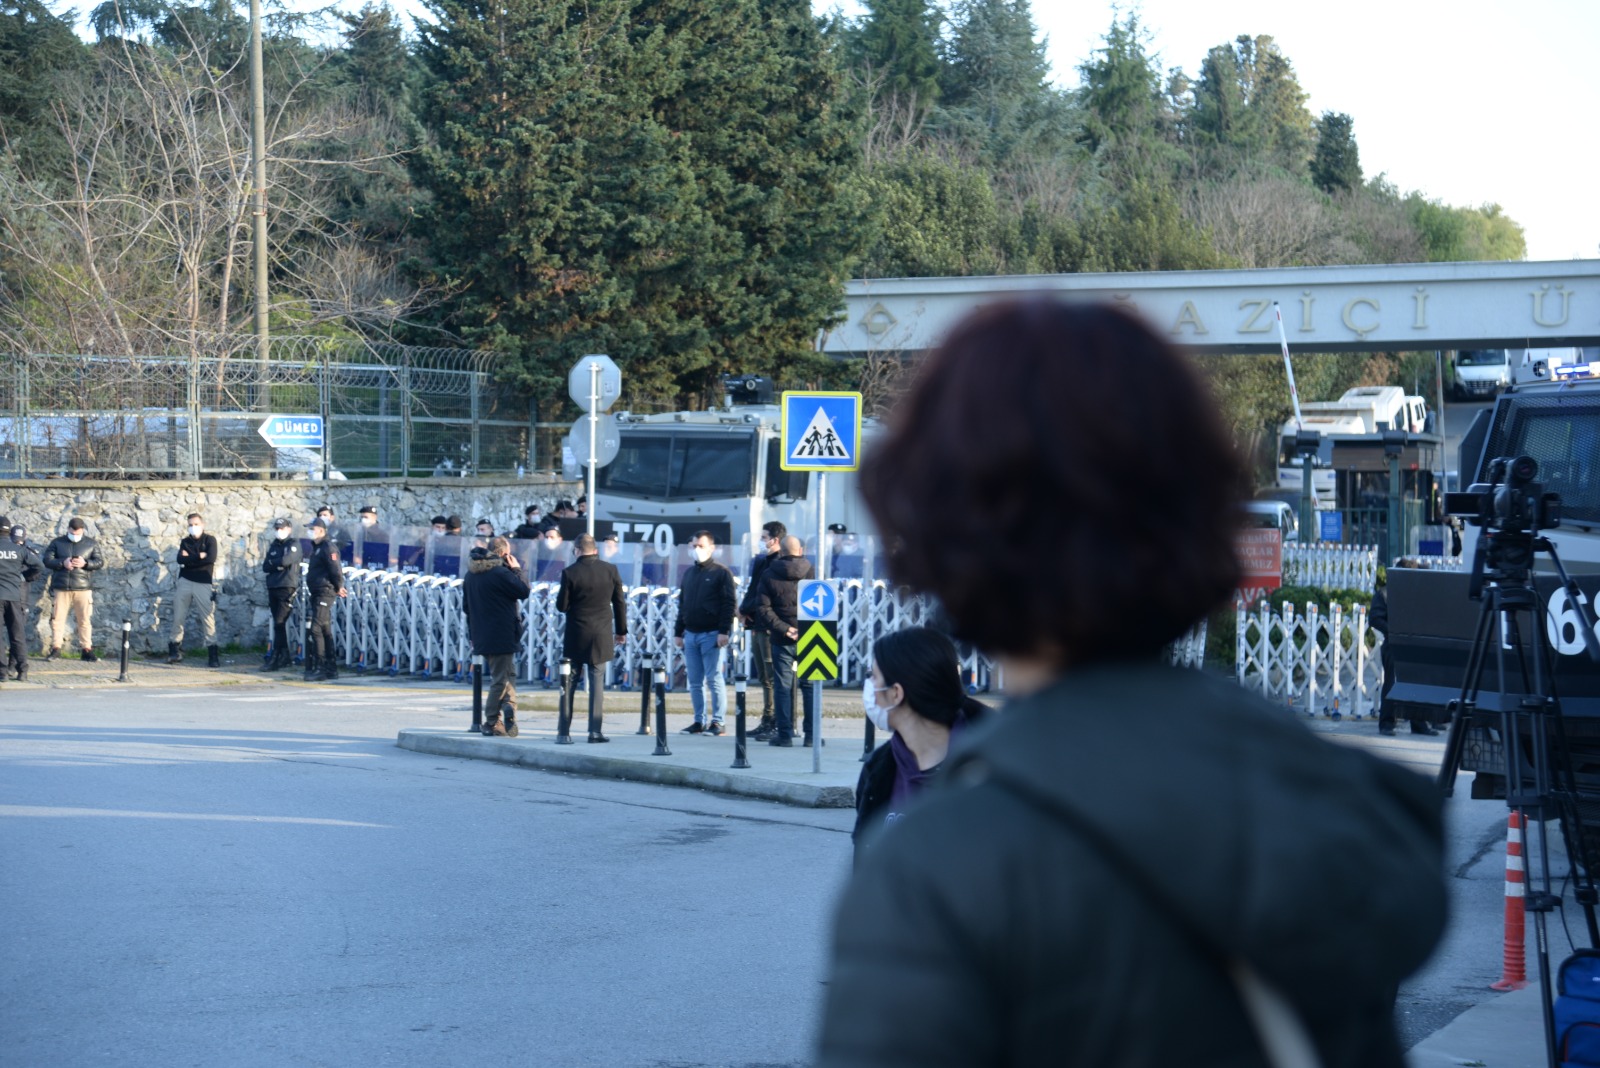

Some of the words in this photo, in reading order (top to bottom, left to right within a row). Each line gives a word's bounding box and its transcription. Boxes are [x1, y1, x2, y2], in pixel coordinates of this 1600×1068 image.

[1112, 286, 1429, 340] AZİÇİ
[275, 420, 318, 433] BÜMED
[1232, 587, 1267, 603] AVA
[1547, 586, 1600, 655] 6
